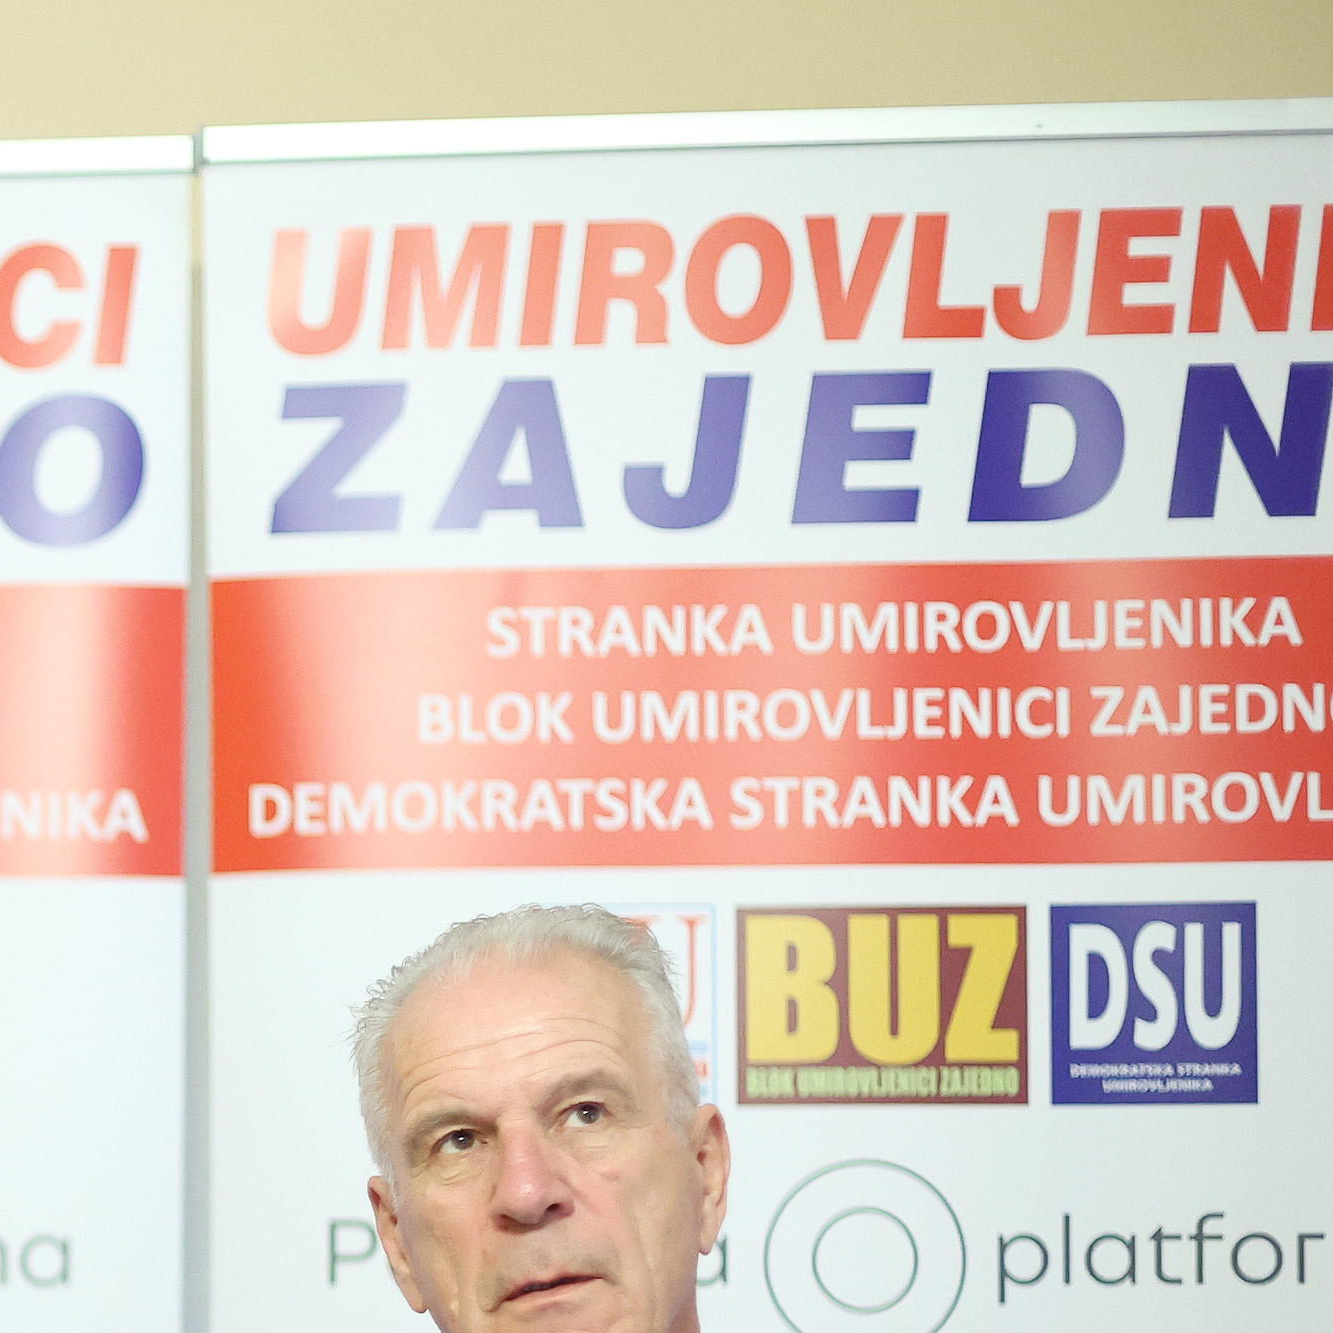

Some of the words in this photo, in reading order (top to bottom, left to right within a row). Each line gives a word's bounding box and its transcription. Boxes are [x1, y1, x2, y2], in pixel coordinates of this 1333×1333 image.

[269, 360, 1333, 536] ZAJEDN
[485, 601, 774, 659] STRANKA
[791, 594, 1302, 654] UMIROVLJENIKA
[416, 691, 574, 747] BLOK
[590, 686, 1071, 744] UMIROVLJENICI
[1087, 682, 1333, 737] ZAJEDN
[247, 777, 712, 839] DEMOKRATSKA
[730, 772, 1020, 831] STRANKA
[1037, 769, 1333, 825] UMIROVL
[745, 912, 1019, 1065] BUZ
[1070, 920, 1243, 1052] DSU
[997, 1211, 1326, 1305] platfor
